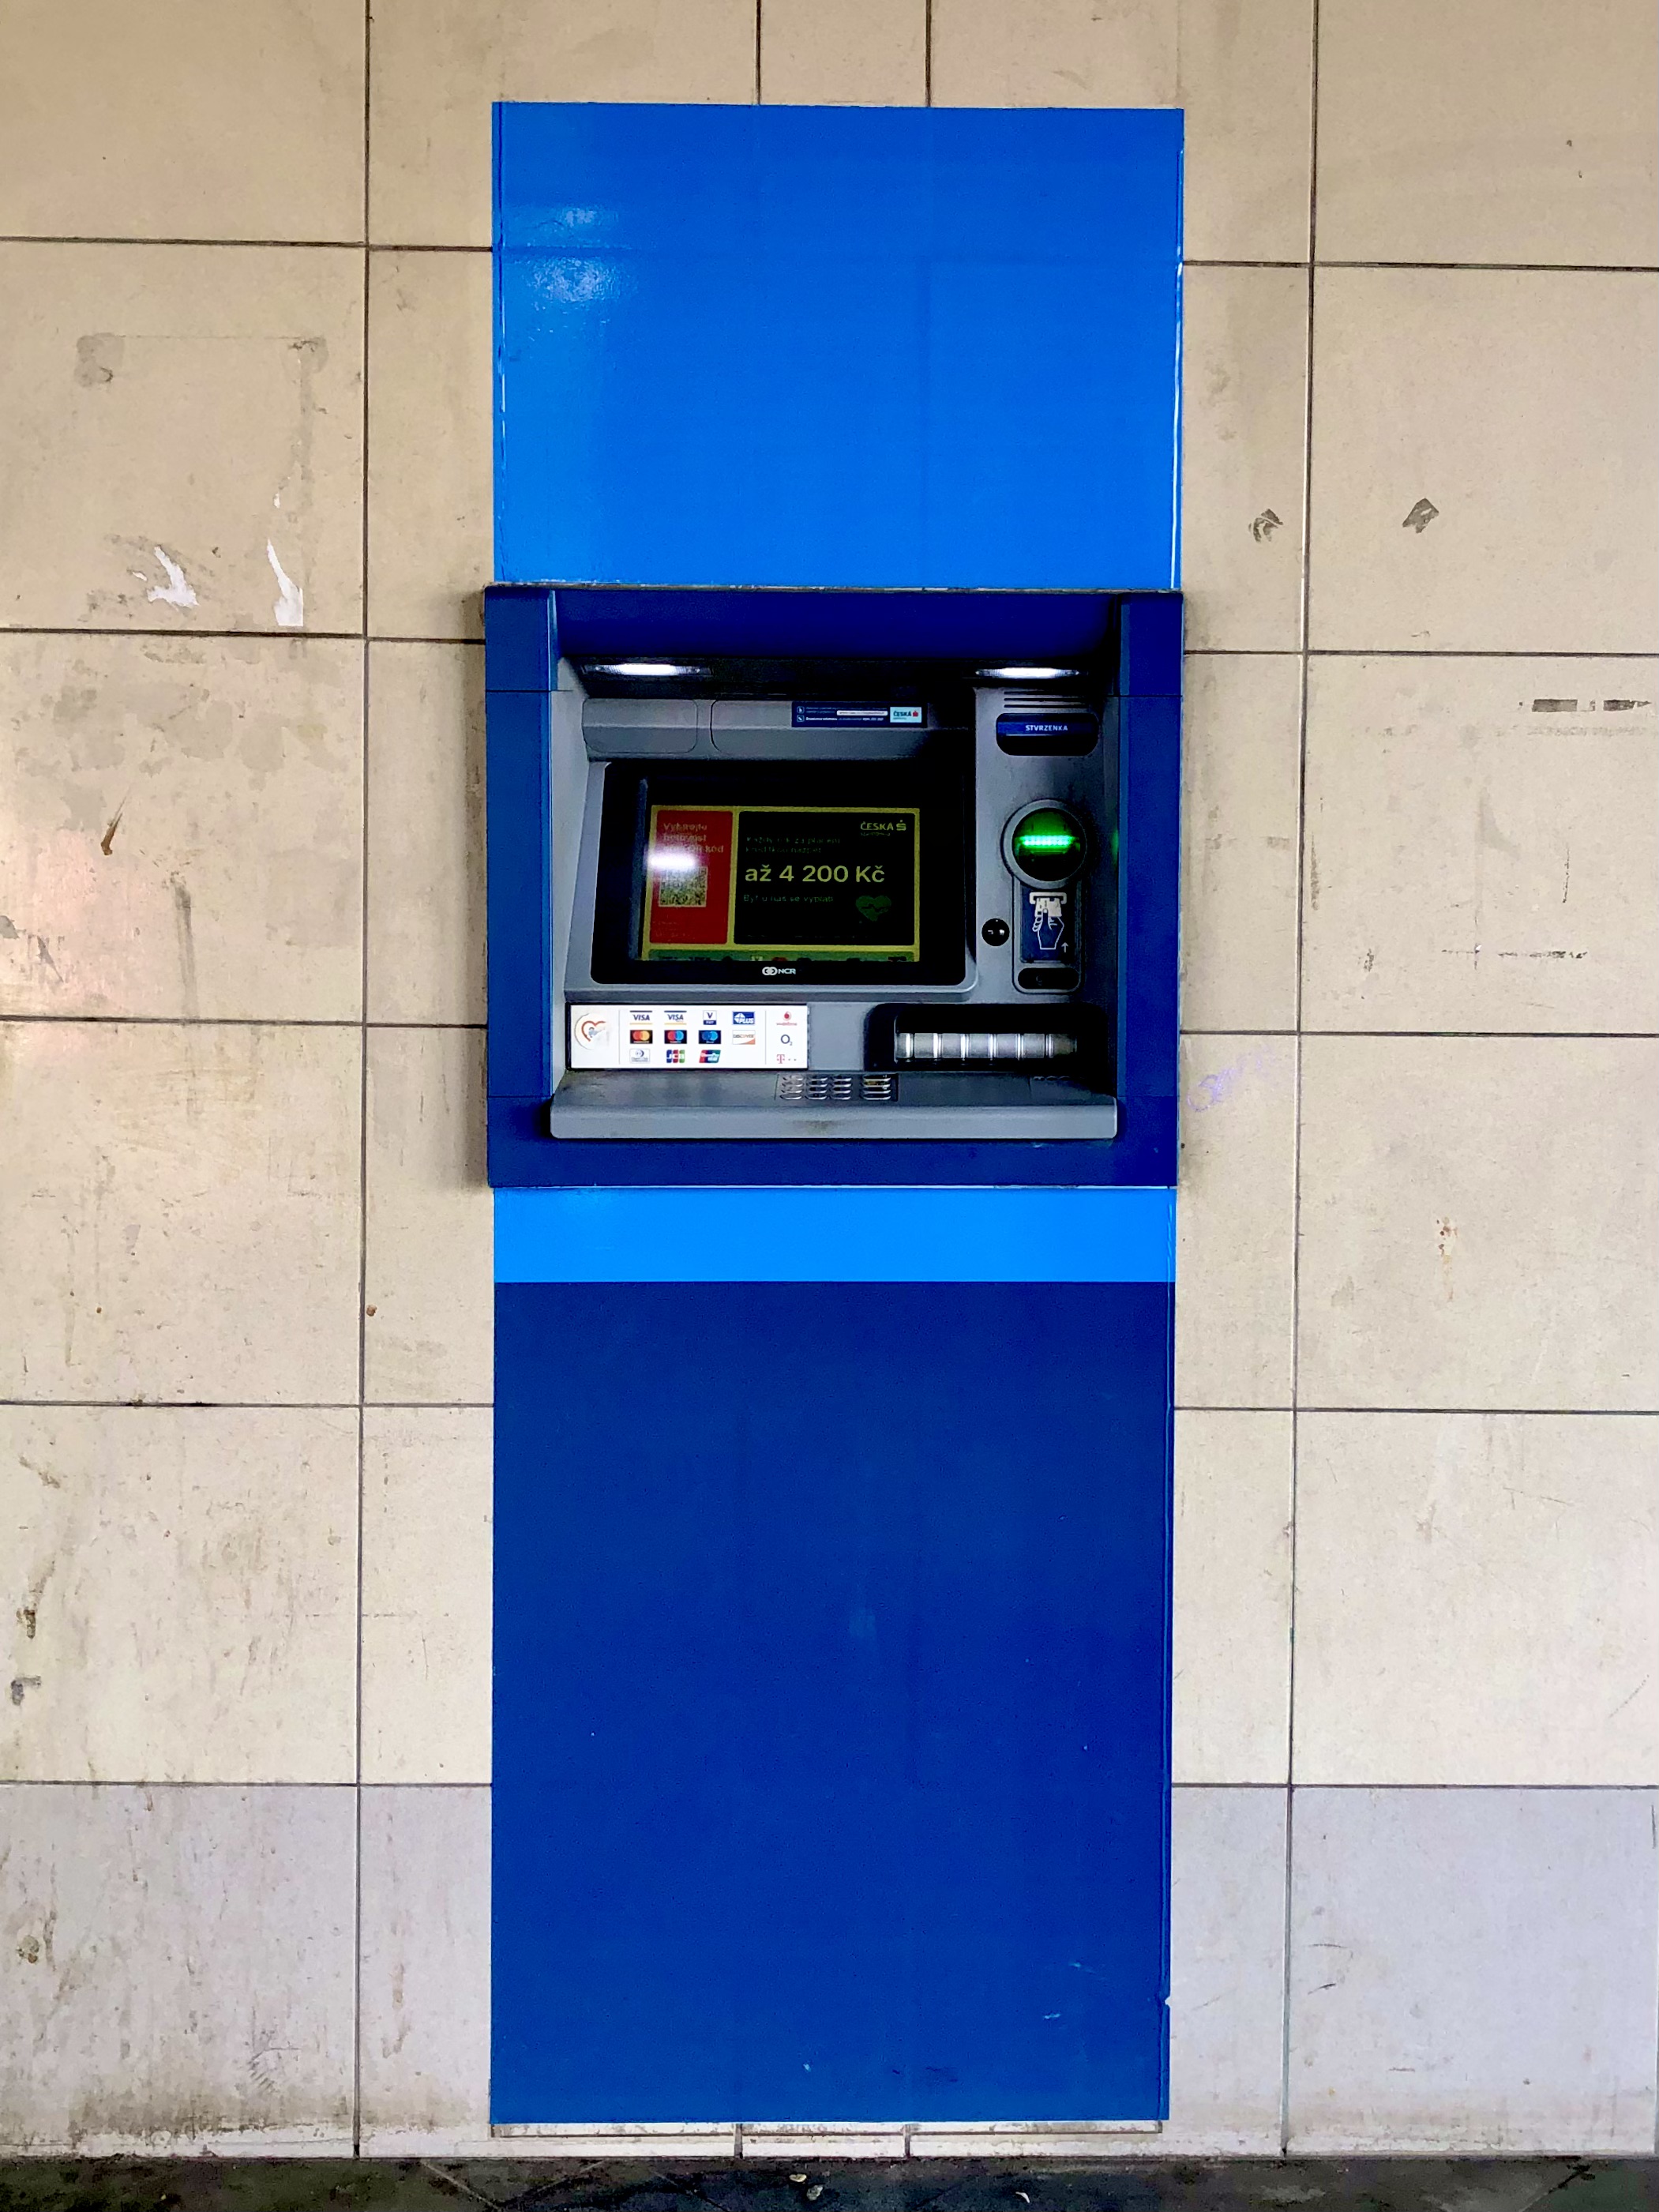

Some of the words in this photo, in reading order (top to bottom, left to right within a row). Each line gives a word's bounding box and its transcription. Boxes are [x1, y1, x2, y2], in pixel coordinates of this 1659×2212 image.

[745, 864, 771, 882] až
[779, 865, 794, 882] 4
[801, 865, 849, 883] 200
[855, 865, 885, 883] Kč
